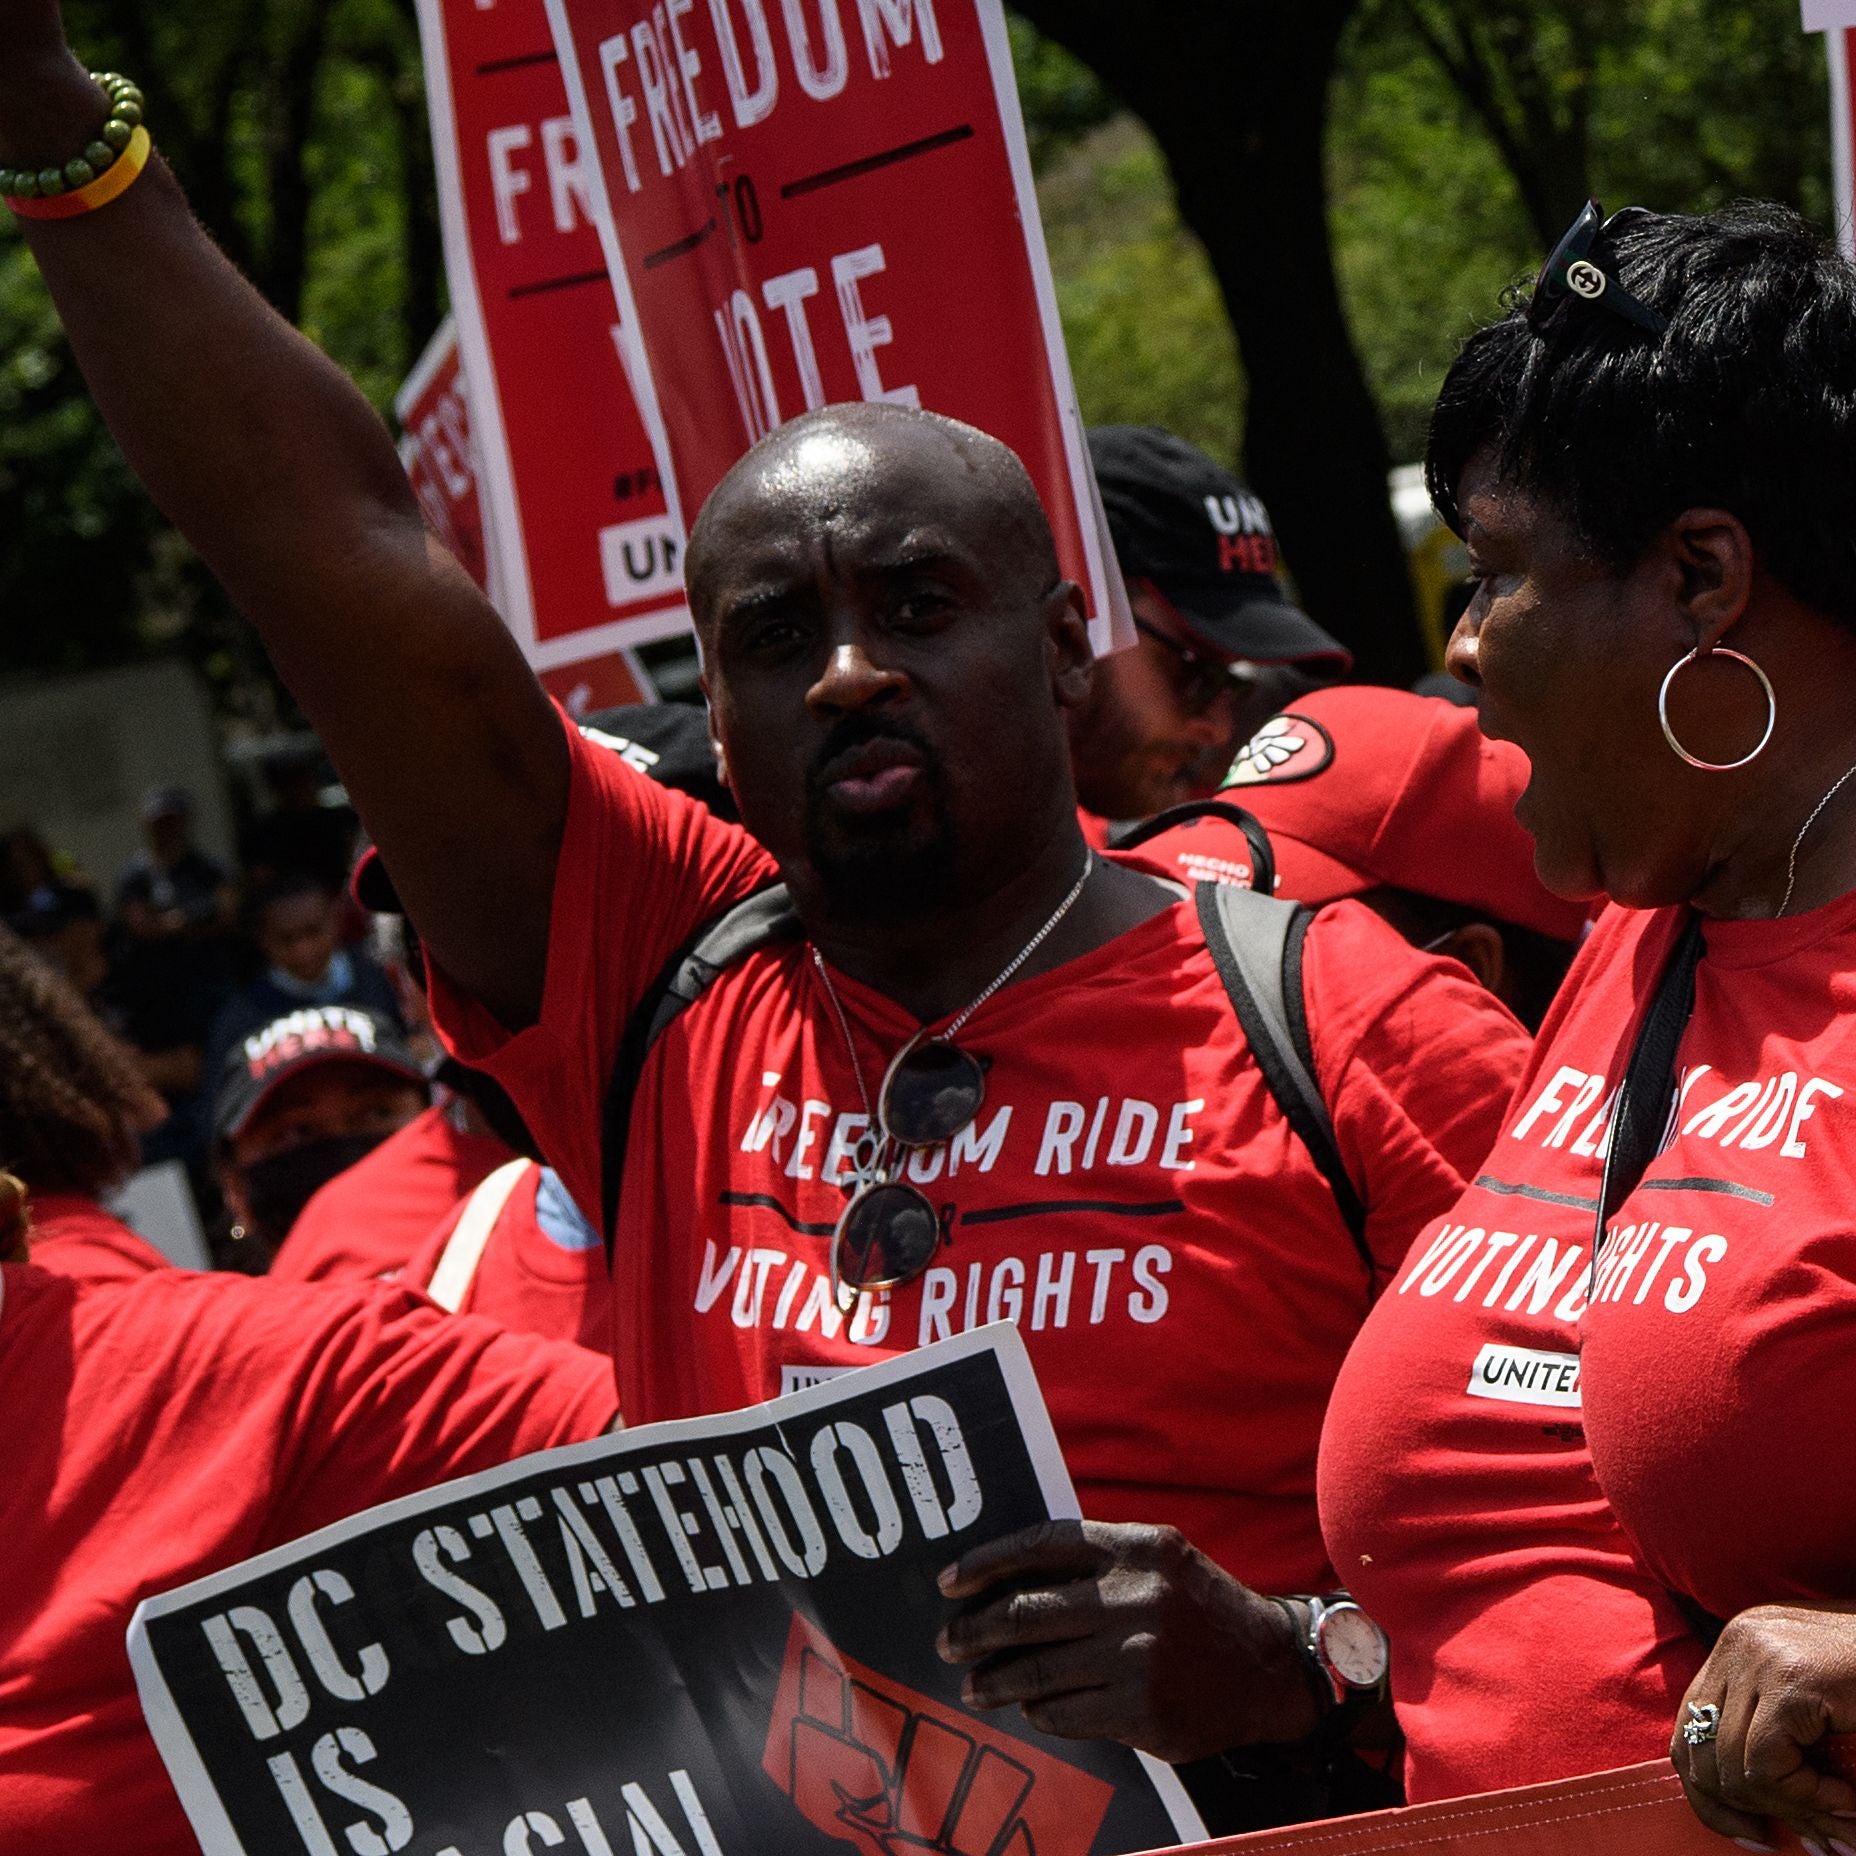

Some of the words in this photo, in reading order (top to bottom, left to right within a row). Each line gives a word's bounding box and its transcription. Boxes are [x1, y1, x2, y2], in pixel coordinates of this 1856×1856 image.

[1034, 1096, 1206, 1177] RIDE
[1681, 1070, 1846, 1159] RIDE
[917, 1243, 1174, 1347] RIGHTS
[1482, 1354, 1583, 1394] UNITE
[201, 1568, 392, 1742] DC
[412, 1393, 985, 1658] STATEHOOD
[265, 1726, 415, 1856] IS
